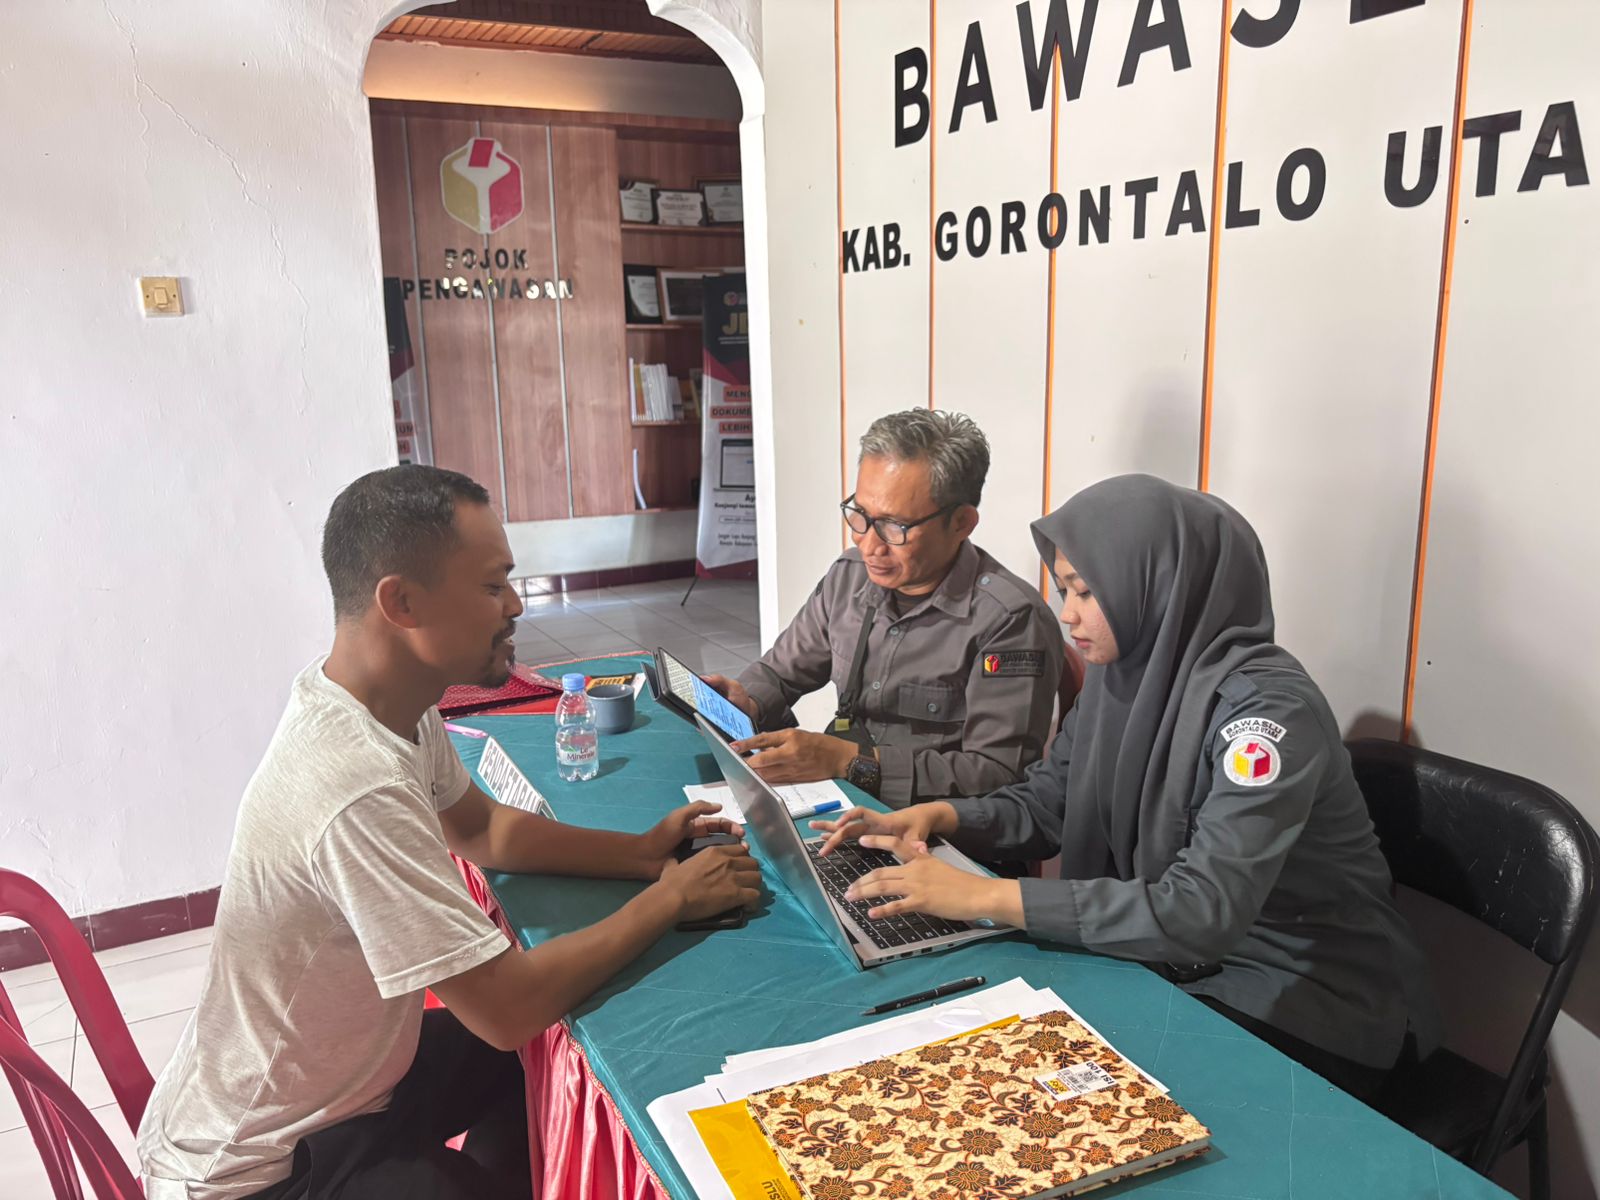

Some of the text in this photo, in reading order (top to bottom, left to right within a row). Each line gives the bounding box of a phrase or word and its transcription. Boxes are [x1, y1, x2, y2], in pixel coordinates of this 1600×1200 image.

[894, 0, 1426, 148] BAWA
[841, 100, 1591, 274] KAB. GORONTALO UTA
[444, 248, 529, 270] POJOK
[403, 277, 574, 300] PENGAWASAN
[1226, 719, 1282, 734] BAWASLU
[1261, 727, 1279, 740] UTARA
[761, 1180, 783, 1200] SLU
